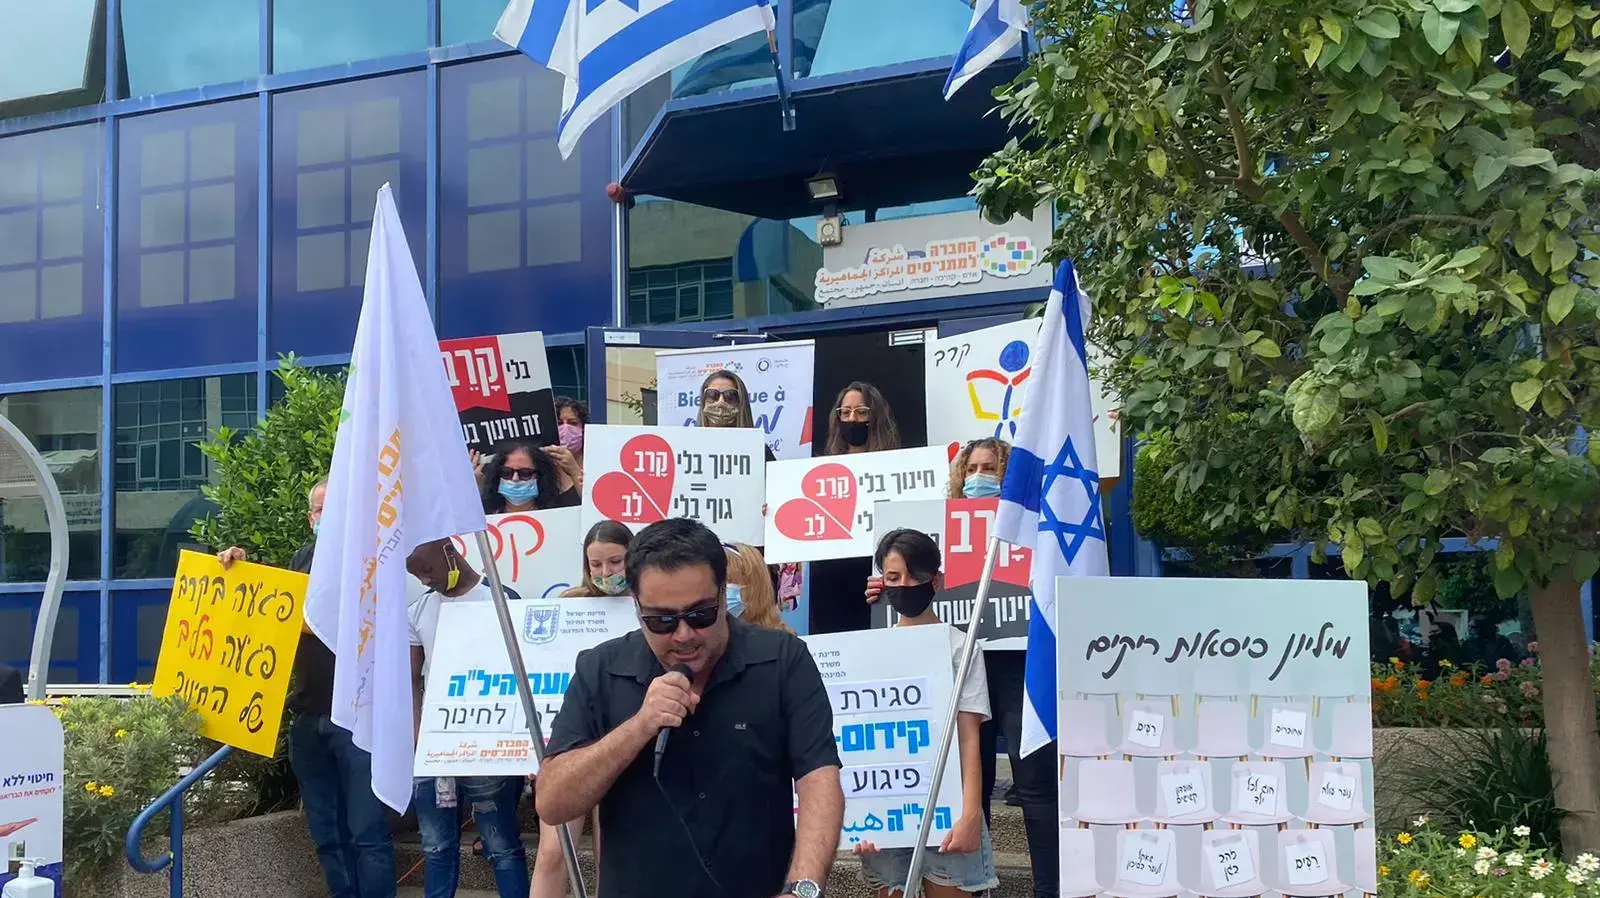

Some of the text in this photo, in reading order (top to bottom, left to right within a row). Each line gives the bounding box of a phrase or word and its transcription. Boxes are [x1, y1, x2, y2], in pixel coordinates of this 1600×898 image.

[871, 250, 904, 265] شركة
[929, 240, 977, 257] החברה
[934, 343, 971, 367] קרב
[505, 359, 531, 380] בלי
[774, 386, 786, 402] à
[481, 417, 520, 446] חינוך
[521, 415, 541, 436] זה
[677, 450, 703, 475] בלי
[709, 454, 750, 479] חינוך
[859, 472, 886, 493] בלי
[891, 469, 935, 494] חינוך
[674, 494, 700, 519] בלי
[706, 498, 732, 524] גוף
[177, 574, 226, 615] בקרב
[177, 614, 214, 661] בלב
[1086, 621, 1350, 681] מיליון כיסאות ריקים
[840, 684, 922, 710] סגירת
[239, 691, 264, 734] של
[437, 702, 507, 730] לחינוך
[3, 772, 54, 788] חיטוי ללא
[852, 767, 921, 793] פיגוע
